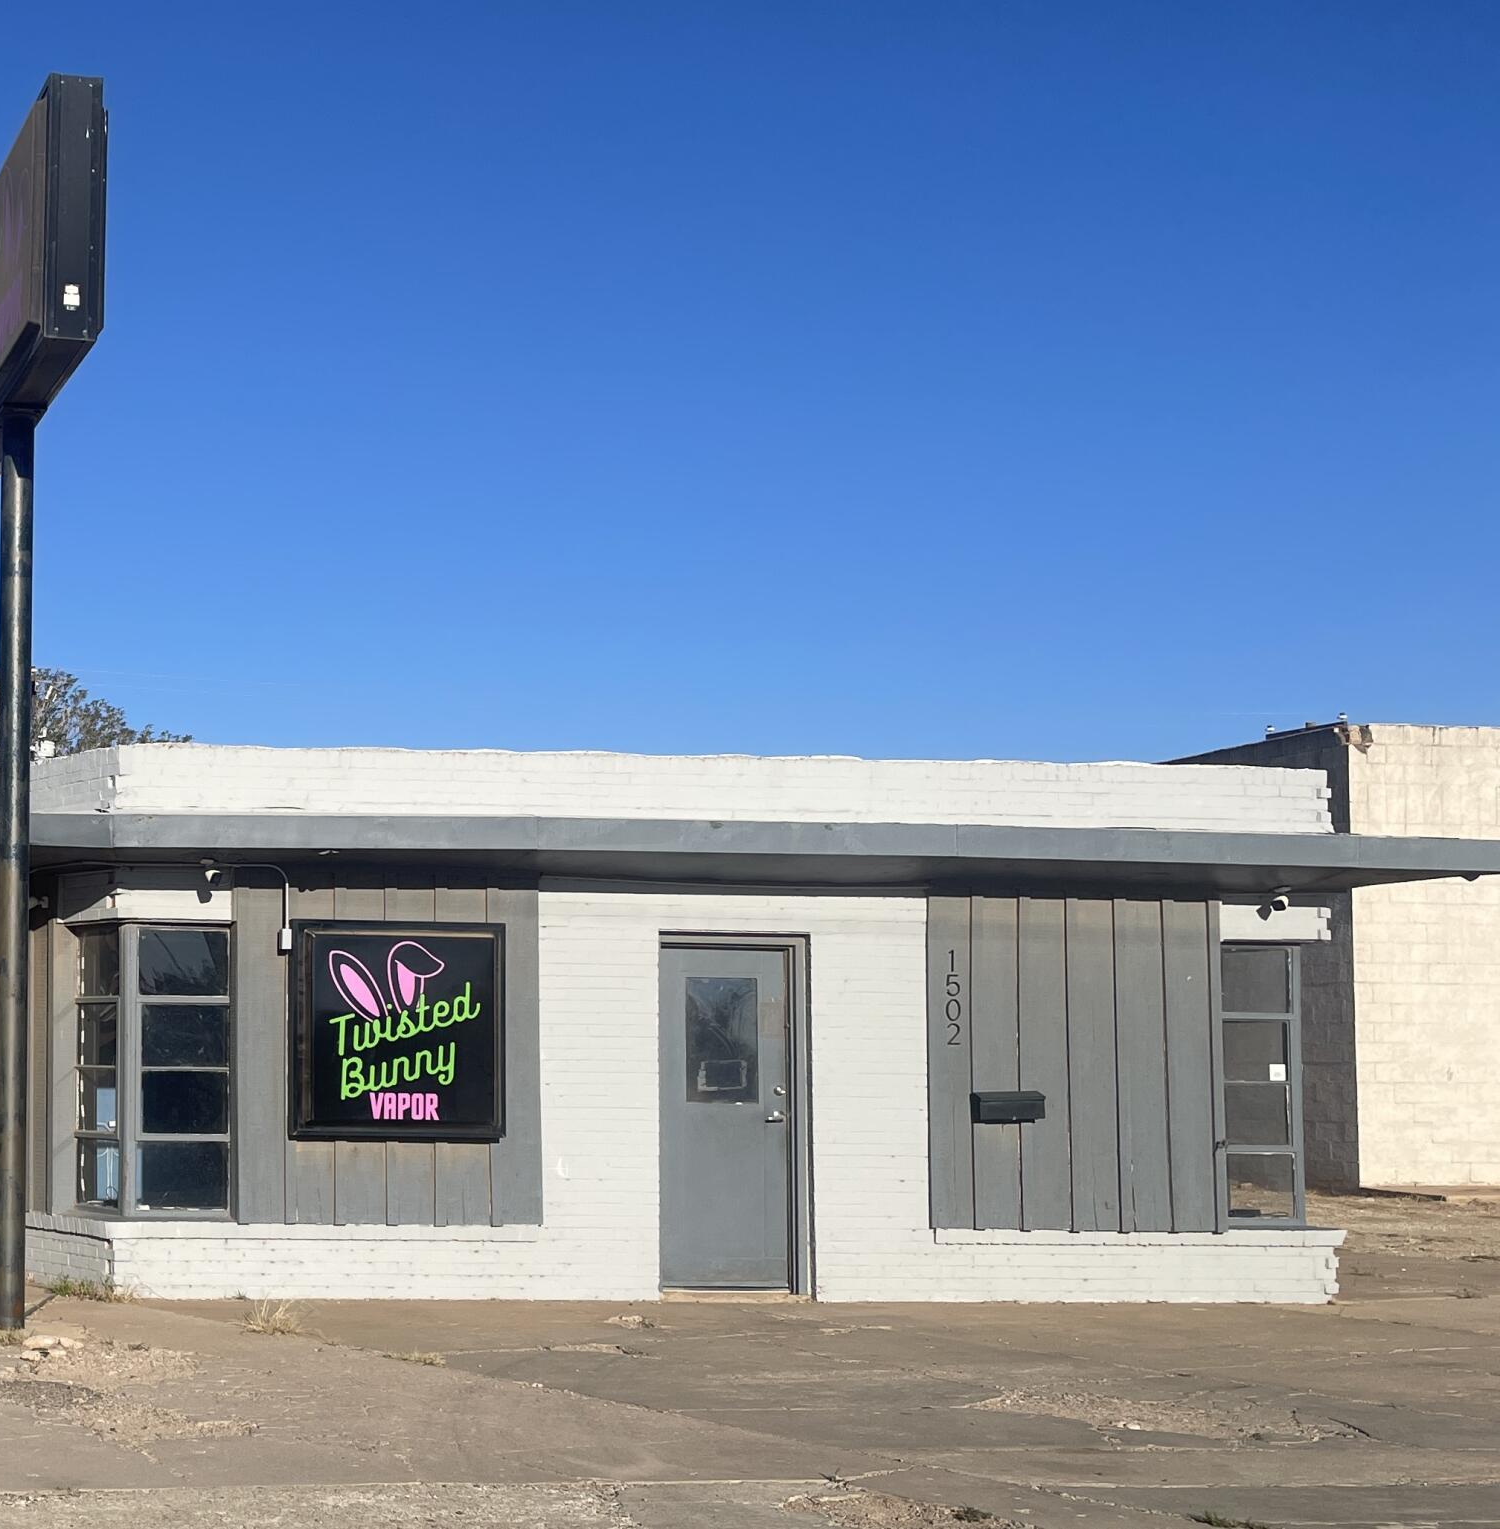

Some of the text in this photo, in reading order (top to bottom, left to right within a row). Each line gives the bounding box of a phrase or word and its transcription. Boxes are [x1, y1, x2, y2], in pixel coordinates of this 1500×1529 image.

[329, 981, 481, 1056] Twisted
[945, 949, 961, 1046] 1502
[340, 1042, 456, 1100] Bunny
[369, 1092, 440, 1120] VAPOR
